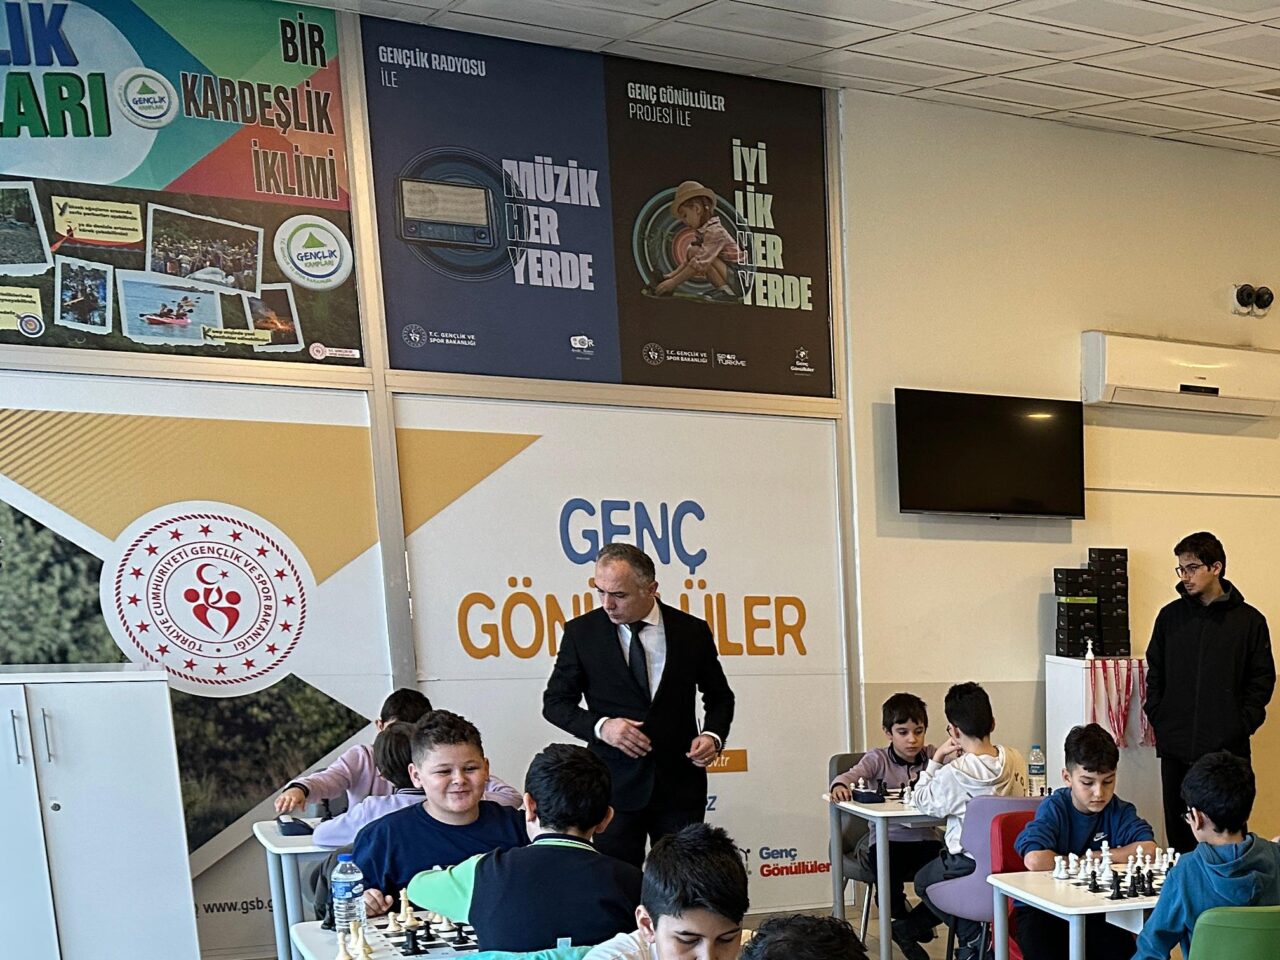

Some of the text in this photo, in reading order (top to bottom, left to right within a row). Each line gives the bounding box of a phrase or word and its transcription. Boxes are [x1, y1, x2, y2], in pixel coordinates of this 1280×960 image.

[279, 12, 328, 68] BİR
[379, 46, 486, 76] GENÇLİK RADYOSU
[381, 67, 398, 88] İLE
[628, 82, 725, 112] GENÇ GÖNÜLLÜLER
[0, 72, 112, 137] ARI
[180, 71, 335, 136] KARDEŞLİK
[629, 102, 692, 127] PROJESİ İLE
[252, 139, 339, 201] İKLİMİ
[502, 156, 600, 208] MÜZİK
[732, 138, 768, 184] İYİ
[505, 203, 560, 246] HER
[734, 184, 774, 229] LİK
[296, 250, 338, 262] GENÇLİK
[507, 246, 594, 290] YERDE
[737, 230, 784, 270] HER
[738, 270, 812, 310] YERDE
[560, 498, 707, 575] GENÇ
[152, 546, 272, 652] TÜRKİYE CUMHURİYETİ GENÇLİK VE SPOR BAKANLIĞI
[759, 847, 798, 860] Genç
[760, 860, 832, 877] Gönüllüler
[203, 898, 274, 914] www.gsb.g
